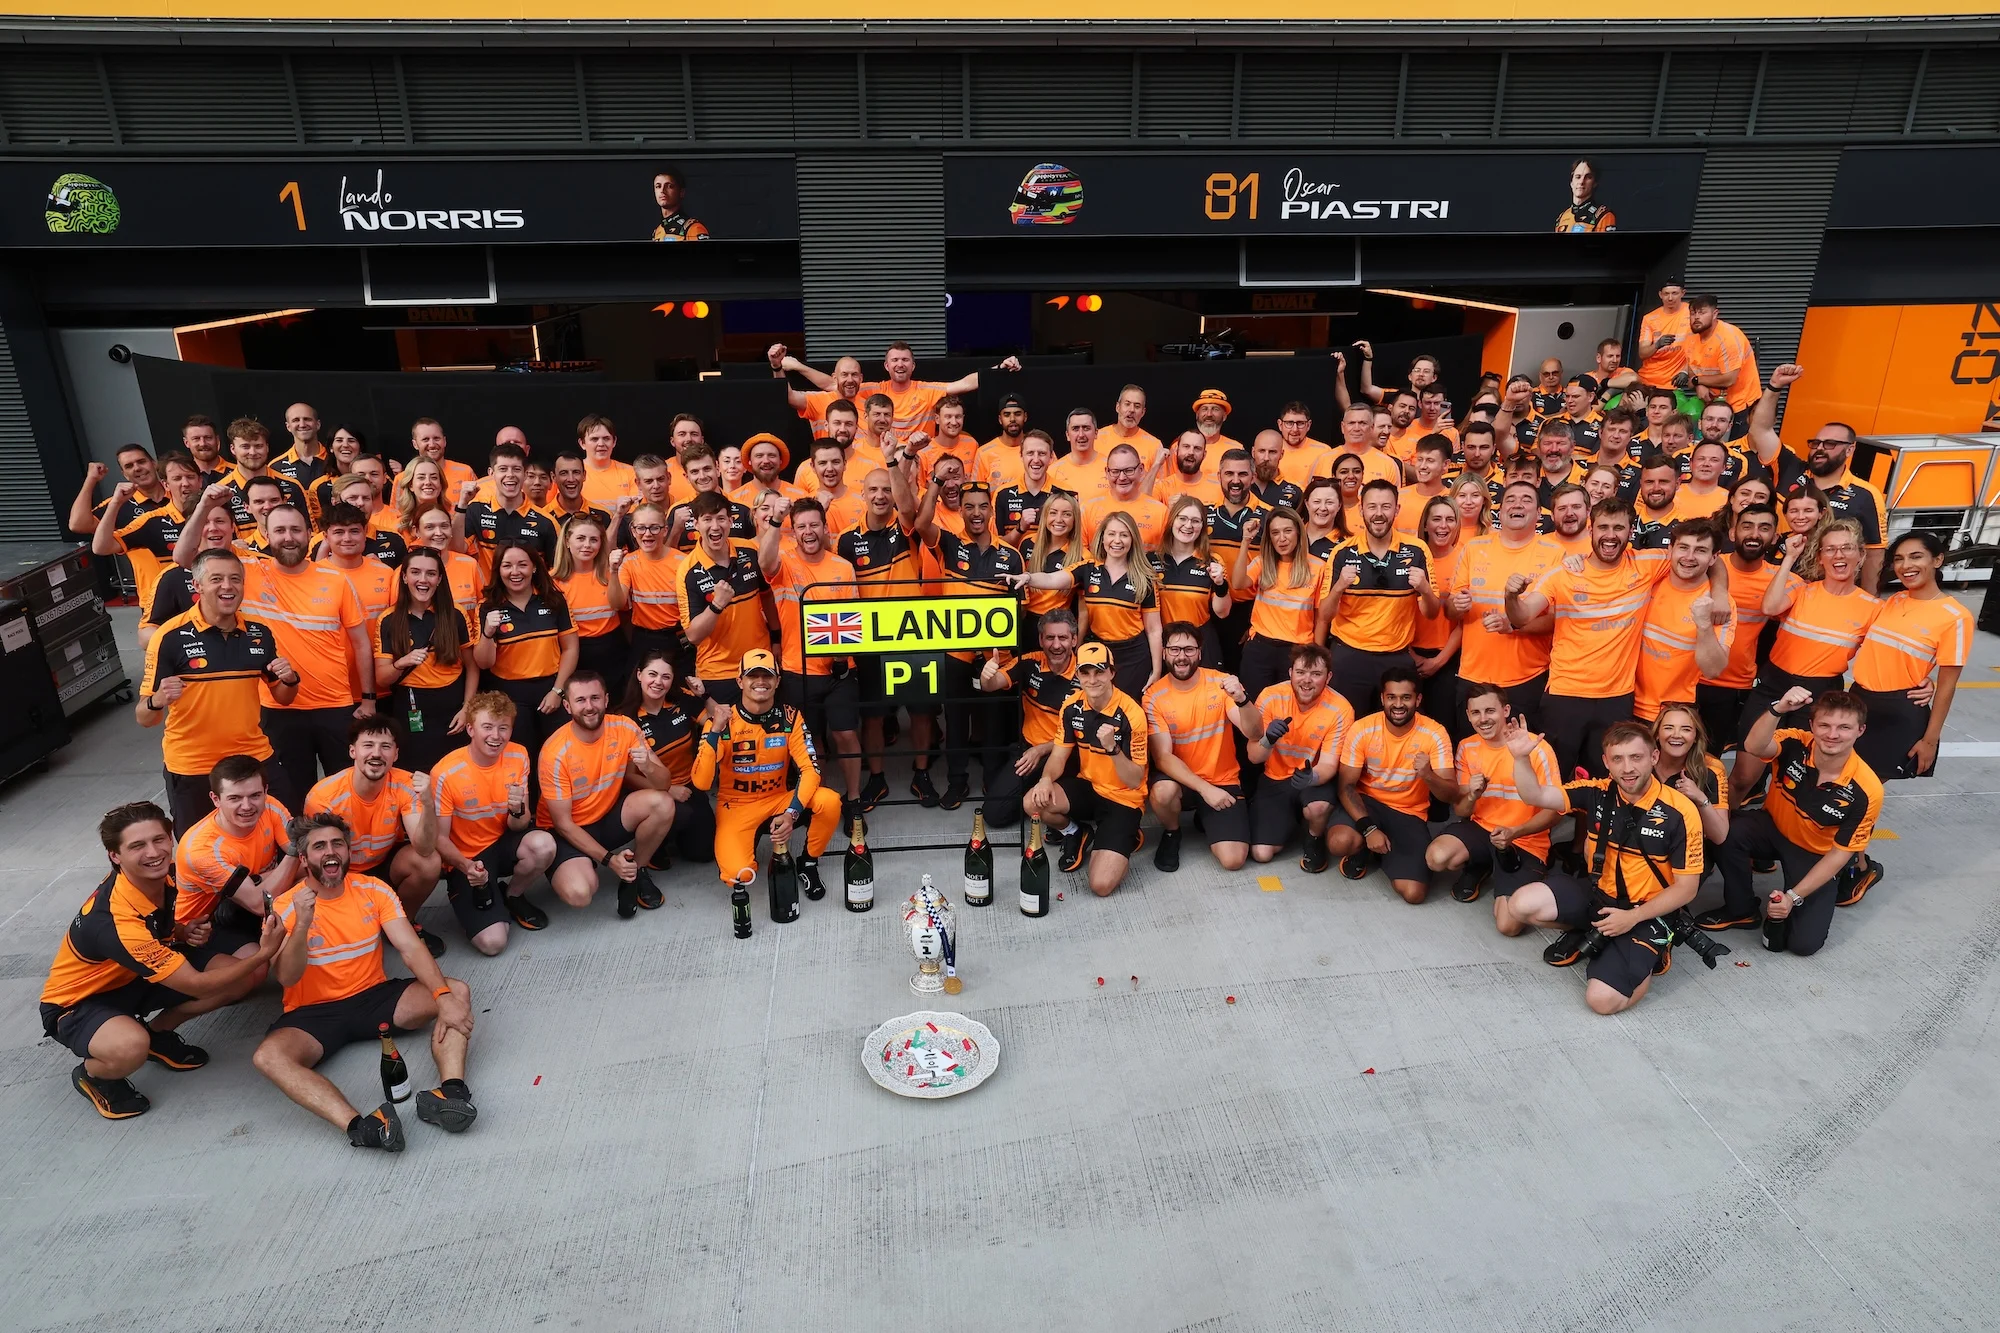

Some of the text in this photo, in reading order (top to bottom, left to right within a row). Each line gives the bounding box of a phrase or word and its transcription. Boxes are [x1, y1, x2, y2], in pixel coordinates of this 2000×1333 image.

[339, 169, 393, 214] Lando
[1283, 167, 1341, 202] Oscar
[1204, 172, 1260, 220] 81
[279, 181, 307, 231] 1
[1281, 200, 1450, 220] PIASTRI
[341, 209, 525, 231] NORRIS
[480, 518, 497, 526] DELL
[520, 529, 539, 537] OKX
[377, 551, 396, 559] OKX
[743, 571, 758, 581] OKX
[699, 582, 715, 591] DELL
[871, 608, 1014, 642] LANDO
[186, 648, 206, 657] DELL
[672, 713, 687, 726] OKX
[1787, 765, 1803, 781] DELL
[733, 776, 783, 793] OKX
[1822, 804, 1845, 819] OKX
[1640, 827, 1664, 838] OKX
[922, 946, 931, 955] 1
